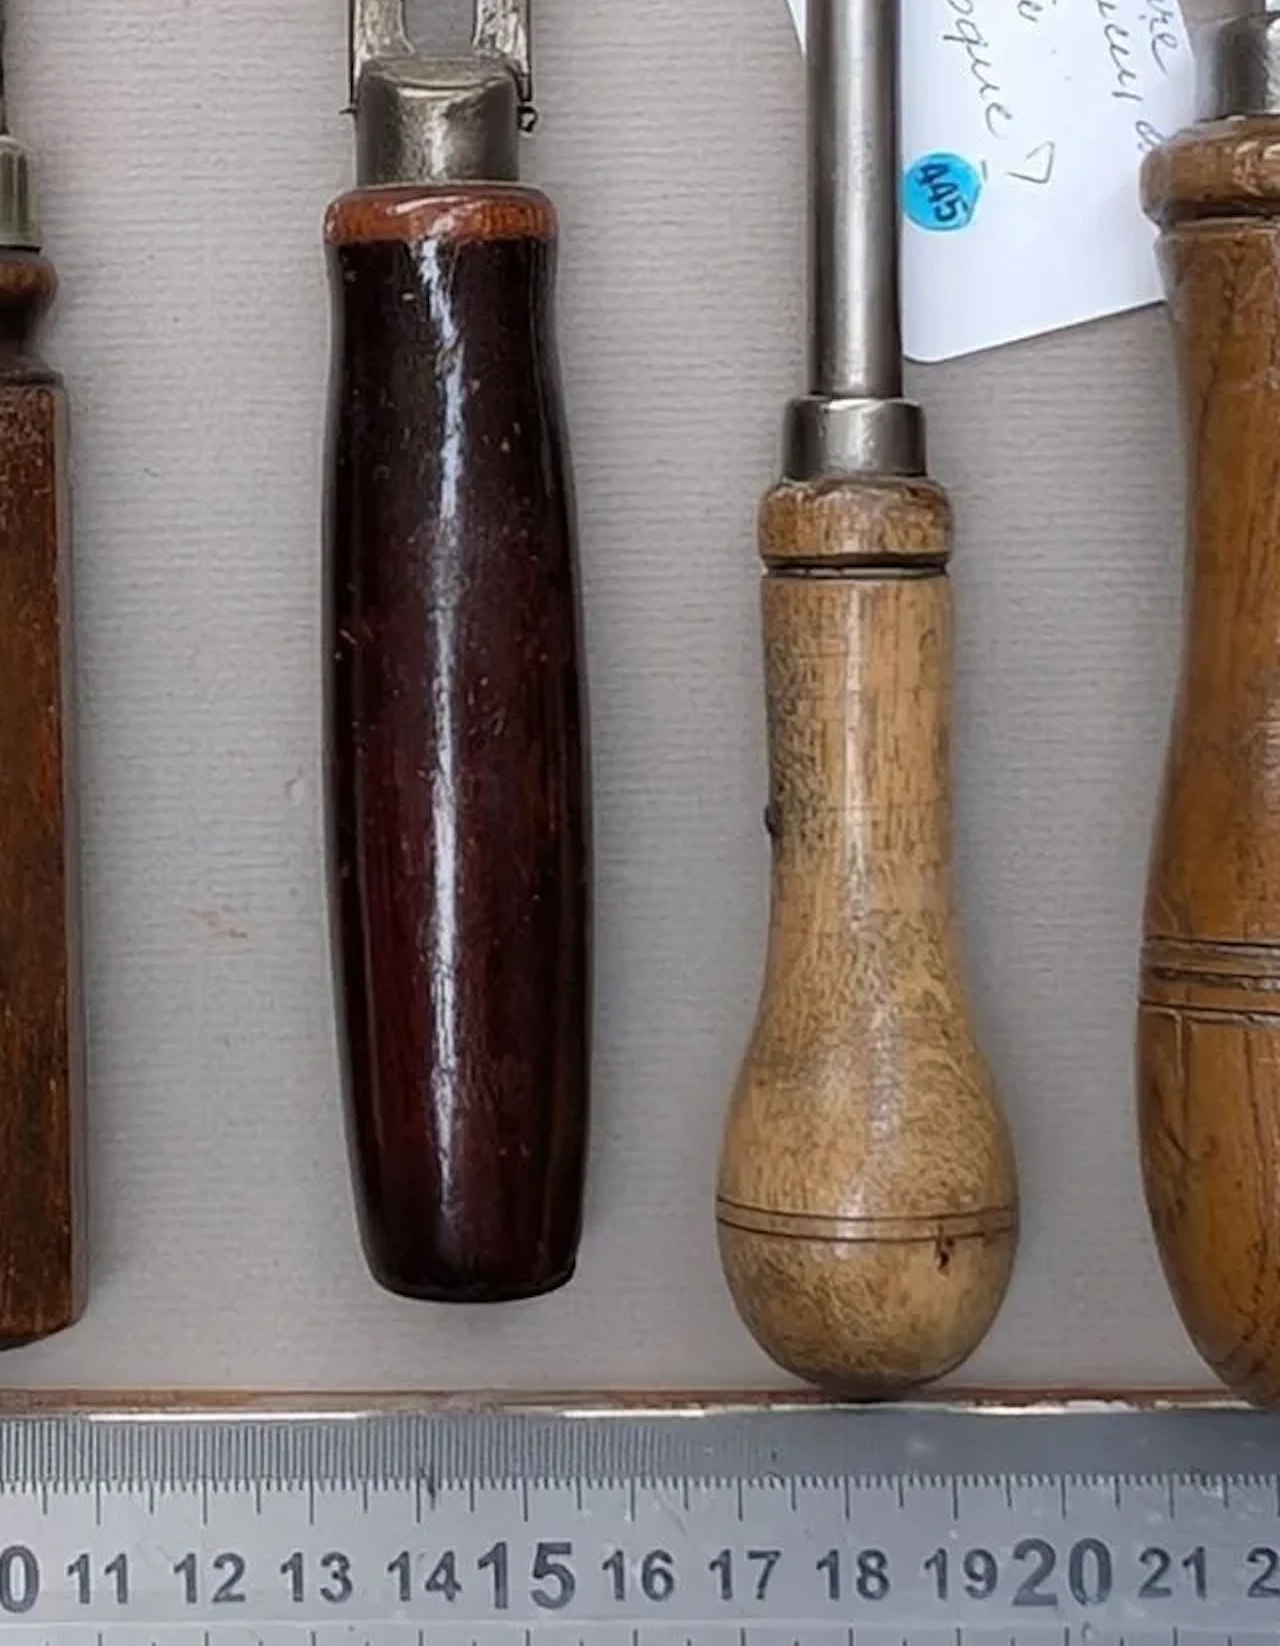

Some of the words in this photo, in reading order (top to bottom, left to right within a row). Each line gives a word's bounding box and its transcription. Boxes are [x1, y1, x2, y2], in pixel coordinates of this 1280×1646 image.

[921, 162, 971, 223] 445
[67, 1552, 128, 1605] 11
[173, 1552, 246, 1605] 12
[280, 1552, 353, 1605] 13
[387, 1550, 463, 1603] 14
[477, 1541, 576, 1610] 15
[602, 1549, 675, 1602] 16
[708, 1549, 782, 1601] 17
[816, 1549, 890, 1602] 18
[924, 1548, 998, 1601] 19
[1012, 1538, 1112, 1610] 20
[1138, 1546, 1207, 1599] 21
